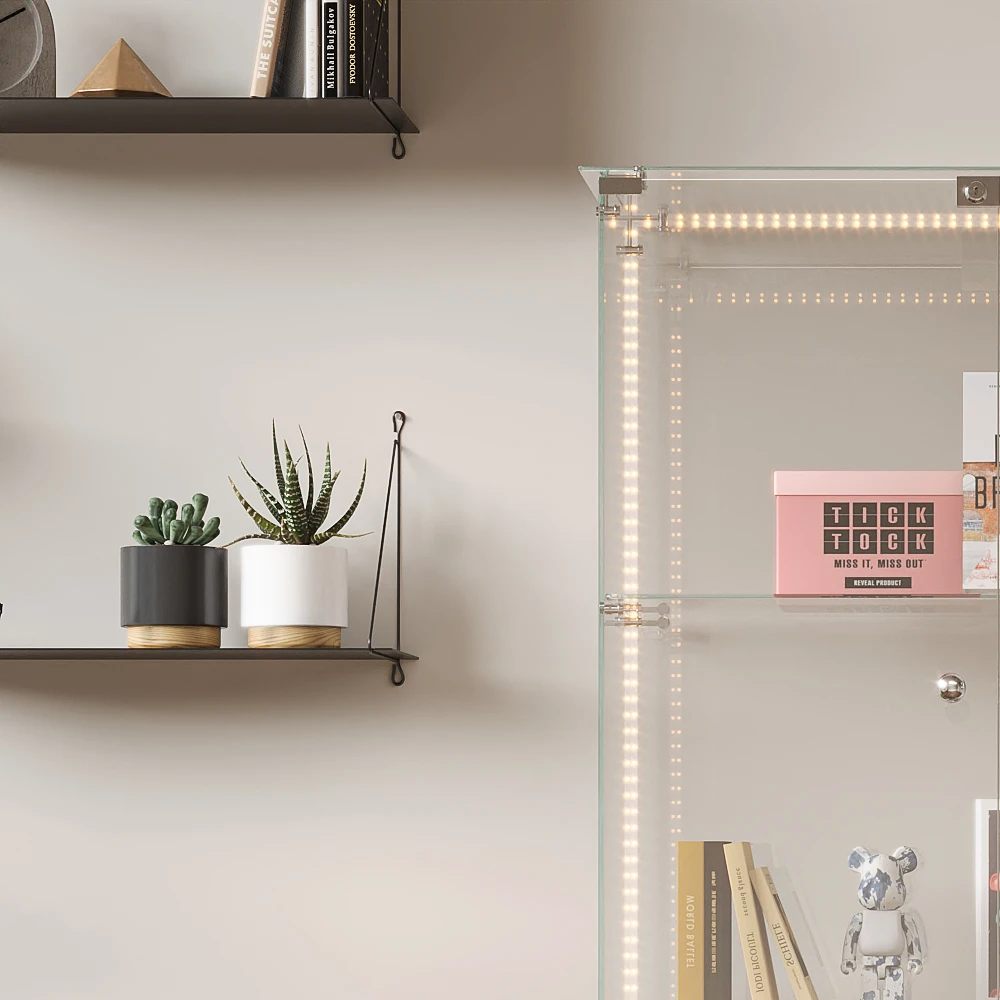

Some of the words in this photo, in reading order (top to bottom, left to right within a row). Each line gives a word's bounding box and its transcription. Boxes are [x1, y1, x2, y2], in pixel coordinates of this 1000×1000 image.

[327, 7, 336, 50] Bulgakov
[257, 52, 271, 80] THE
[326, 52, 335, 89] Mikhail
[830, 505, 928, 525] TICK
[830, 532, 928, 551] TOCK
[834, 559, 859, 568] MISS
[862, 559, 874, 570] IT,
[877, 559, 902, 568] MISS
